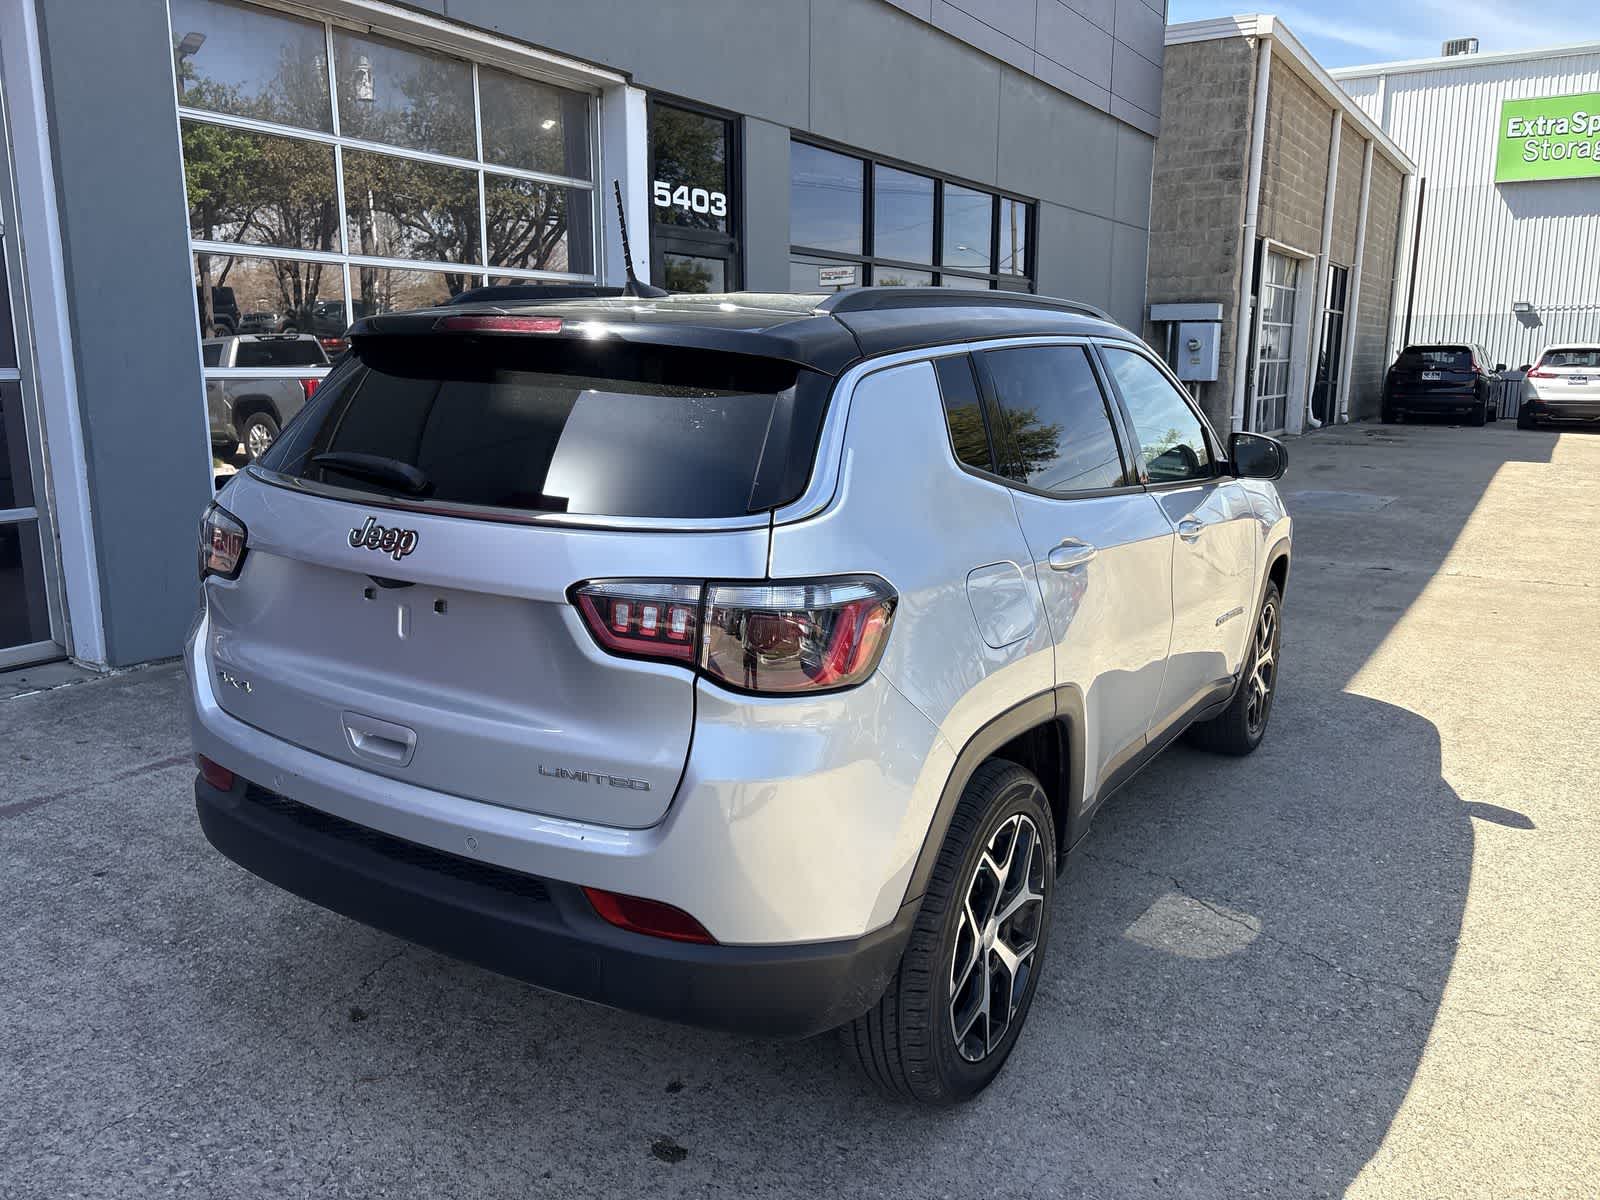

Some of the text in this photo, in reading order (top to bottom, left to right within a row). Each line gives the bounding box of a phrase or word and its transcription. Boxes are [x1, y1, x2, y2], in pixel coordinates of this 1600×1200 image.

[653, 180, 727, 217] 5403
[347, 516, 419, 561] Jeep
[538, 762, 651, 792] LIMITED
